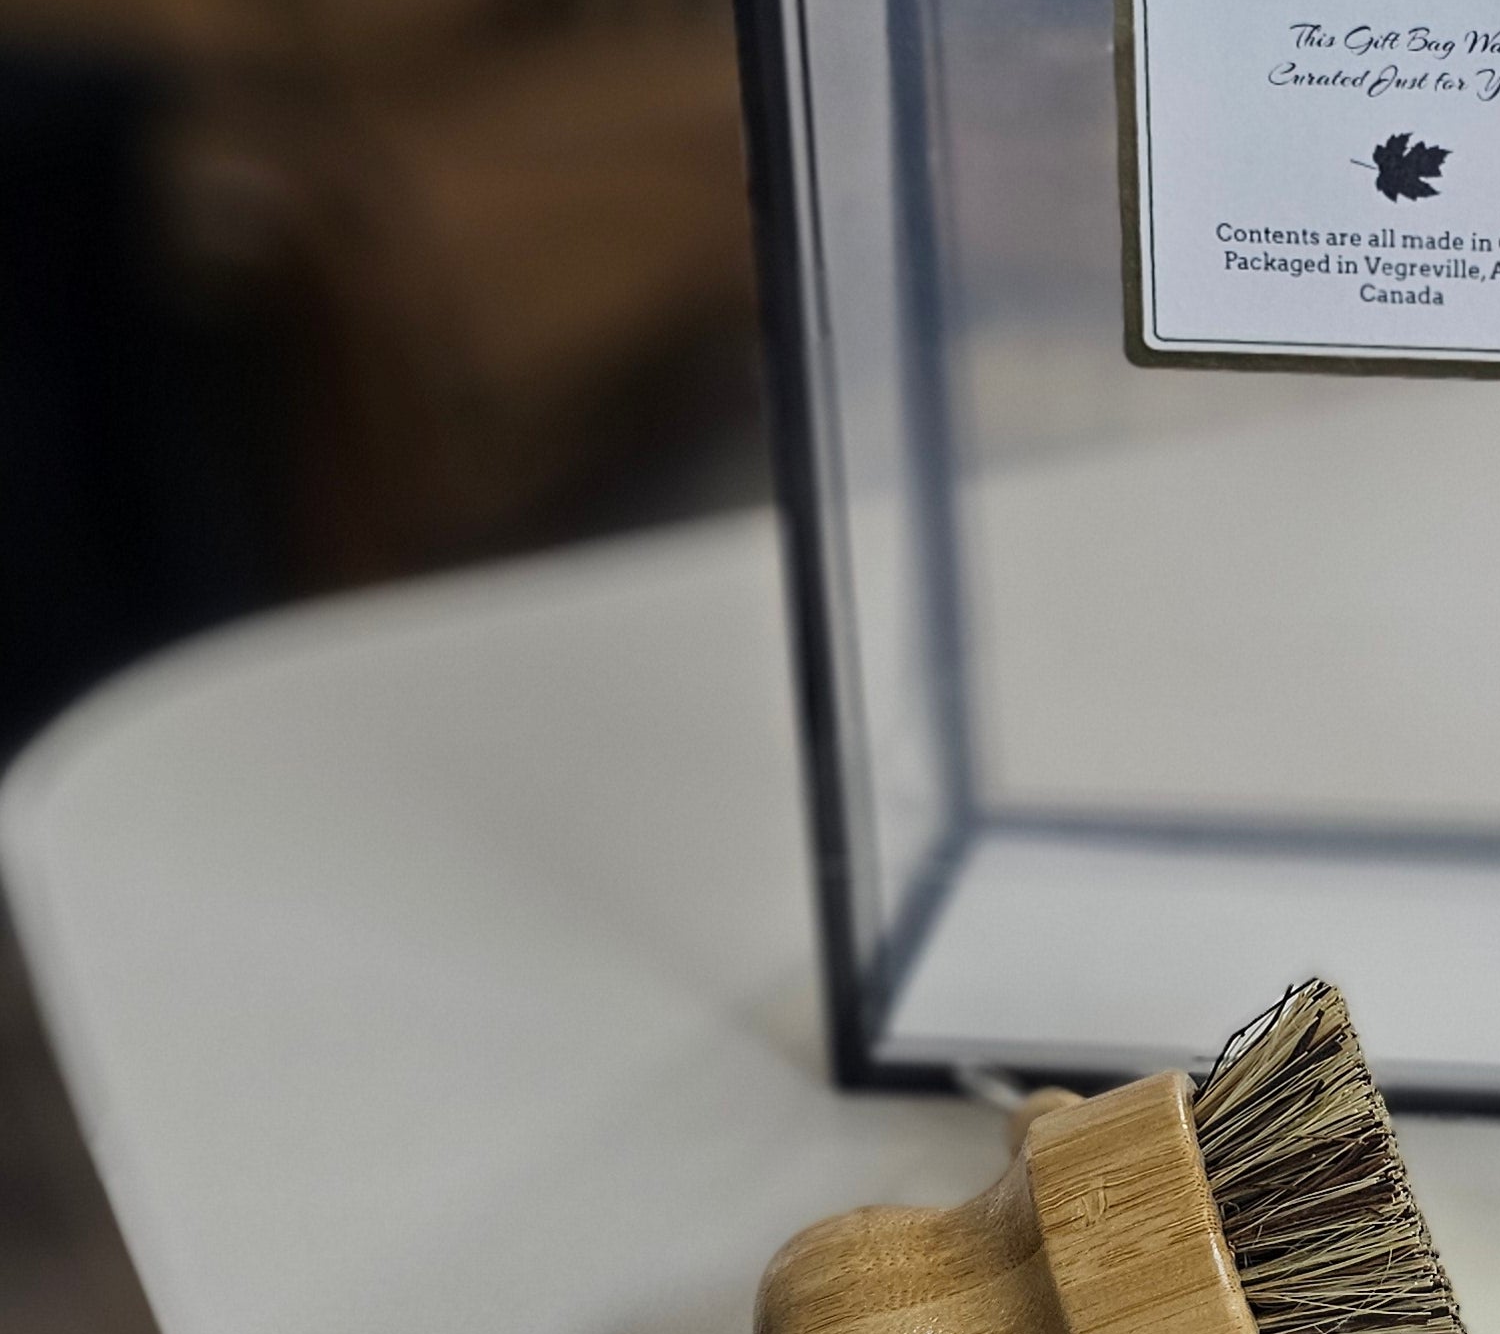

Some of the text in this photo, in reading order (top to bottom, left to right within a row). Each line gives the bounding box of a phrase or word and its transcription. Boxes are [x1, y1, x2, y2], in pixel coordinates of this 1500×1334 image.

[1290, 23, 1335, 49] This
[1344, 25, 1401, 55] Gift
[1407, 27, 1455, 59] Bag
[1268, 62, 1370, 88] Curated
[1367, 65, 1428, 97] Just
[1434, 72, 1467, 93] for
[1216, 222, 1320, 246] Contents
[1326, 231, 1361, 247] are
[1368, 228, 1395, 248] all
[1401, 231, 1464, 251] made
[1471, 231, 1492, 253] in
[1224, 251, 1330, 277] Packaged
[1337, 254, 1358, 275] in
[1364, 256, 1486, 283] Vegreville,
[1359, 283, 1444, 306] Canada
